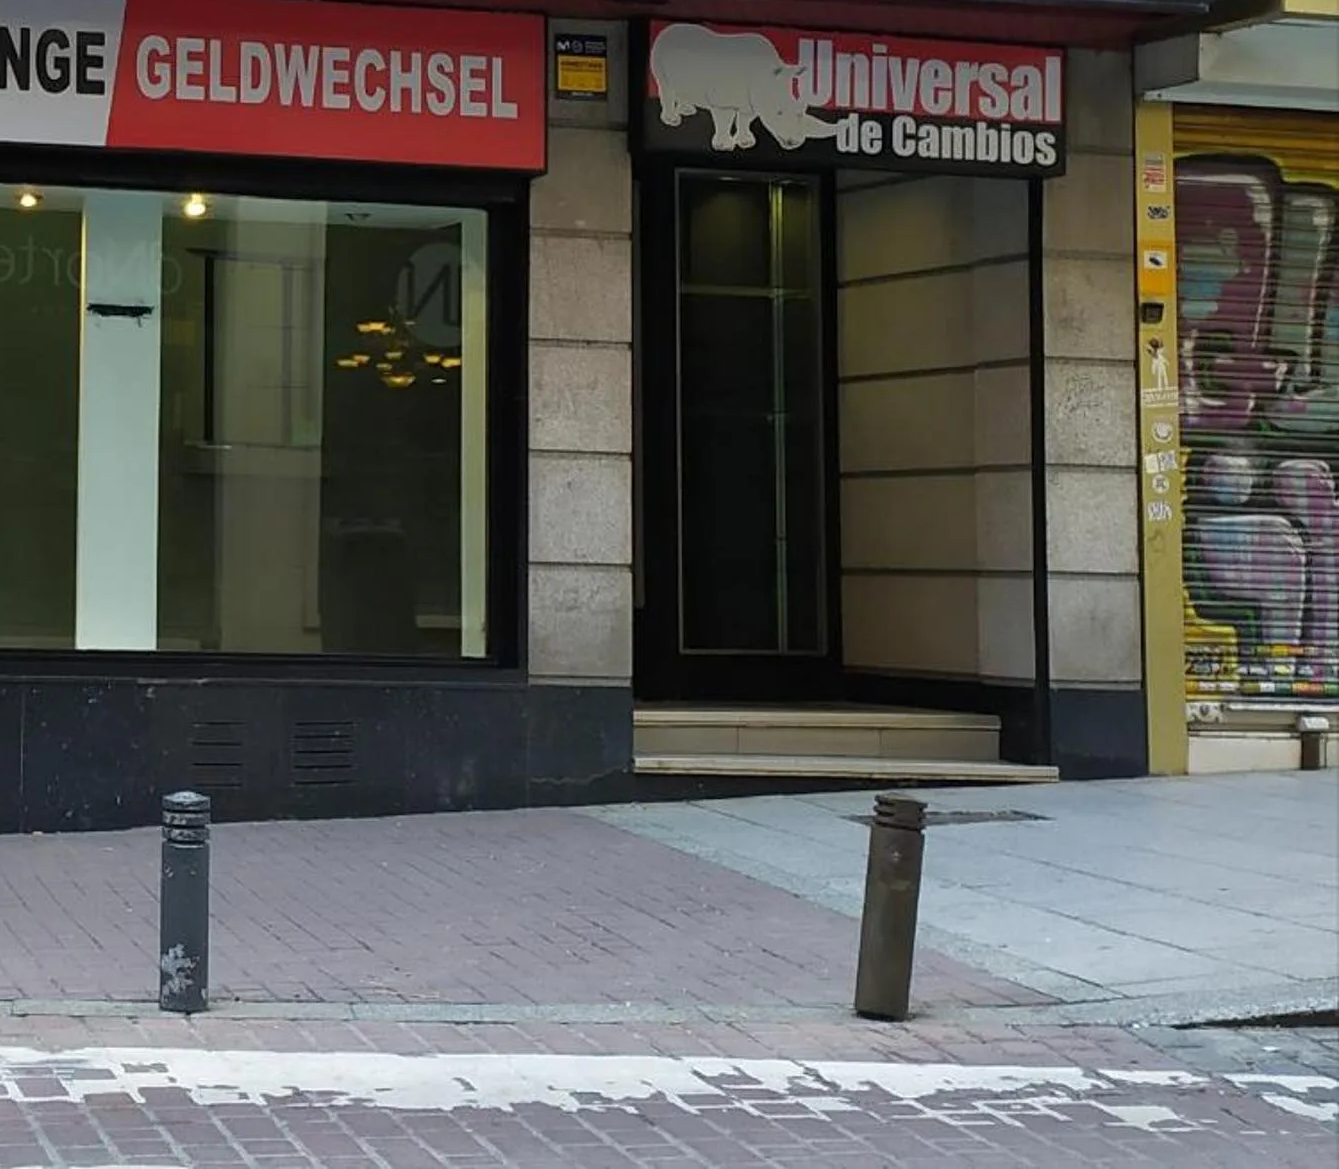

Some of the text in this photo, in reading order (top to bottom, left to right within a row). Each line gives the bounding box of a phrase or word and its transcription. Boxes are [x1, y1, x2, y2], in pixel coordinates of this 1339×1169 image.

[135, 34, 519, 120] GELDWECHSEL
[792, 39, 1061, 123] Universal
[835, 113, 1059, 167] de Cambios
